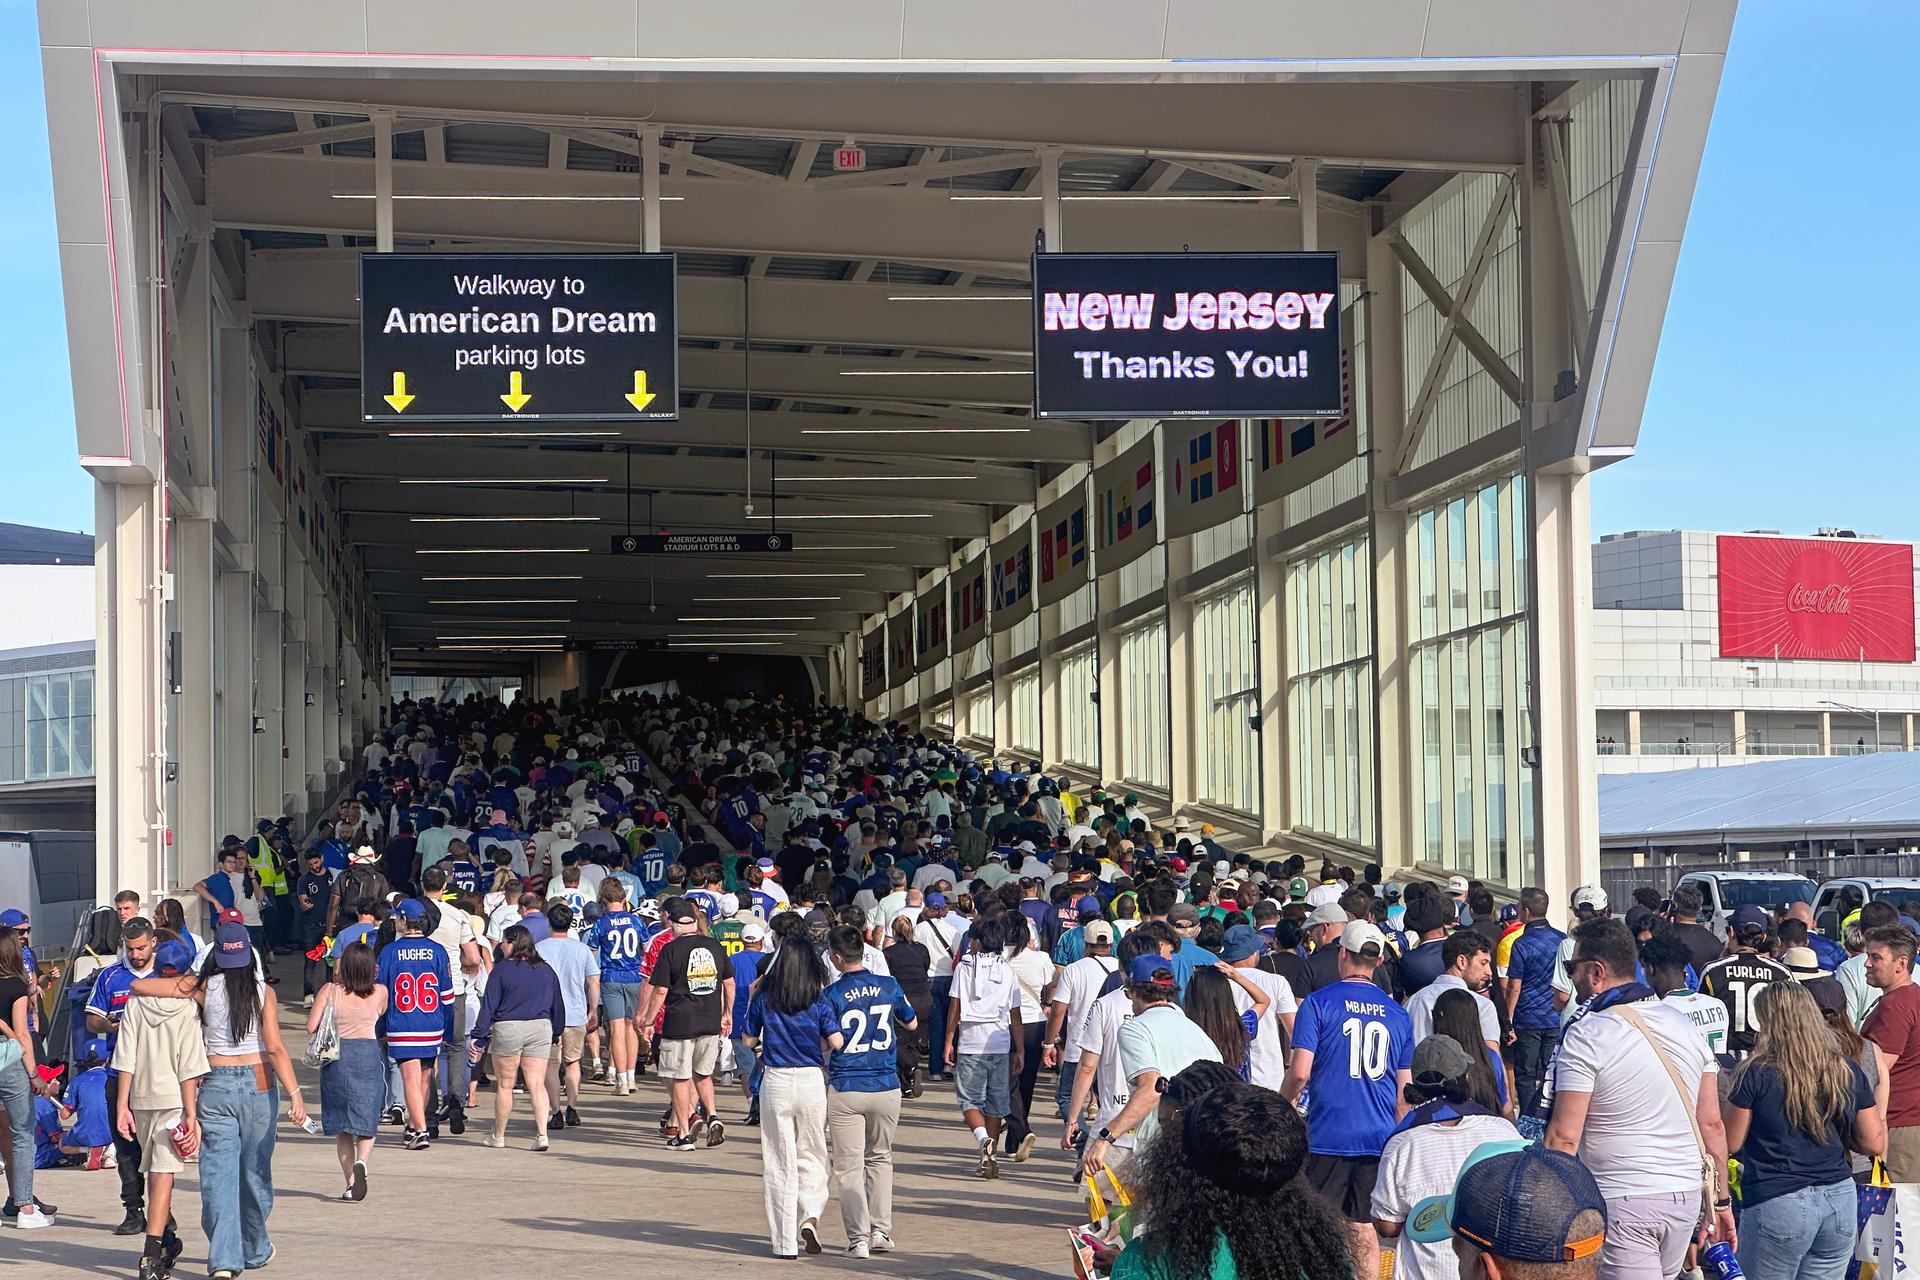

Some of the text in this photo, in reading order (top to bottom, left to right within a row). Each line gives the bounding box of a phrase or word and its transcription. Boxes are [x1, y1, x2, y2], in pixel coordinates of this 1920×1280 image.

[840, 150, 861, 167] EXIT
[453, 274, 585, 299] Walkway to
[382, 306, 657, 334] American Dream
[455, 344, 585, 370] parking lots
[1073, 350, 1309, 379] Thanks You!
[700, 543, 719, 551] LOTS
[726, 543, 734, 551] &
[1786, 582, 1853, 614] Coca-Cola
[732, 800, 748, 818] 10
[643, 860, 664, 882] 10
[398, 949, 433, 961] HUGHES
[607, 928, 638, 959] 20
[1725, 966, 1772, 980] FURLAN
[395, 972, 439, 1014] 86
[844, 986, 881, 1002] SHAW
[1345, 1000, 1385, 1017] MBAPPE
[841, 1004, 892, 1053] 23
[1342, 1018, 1390, 1081] 10
